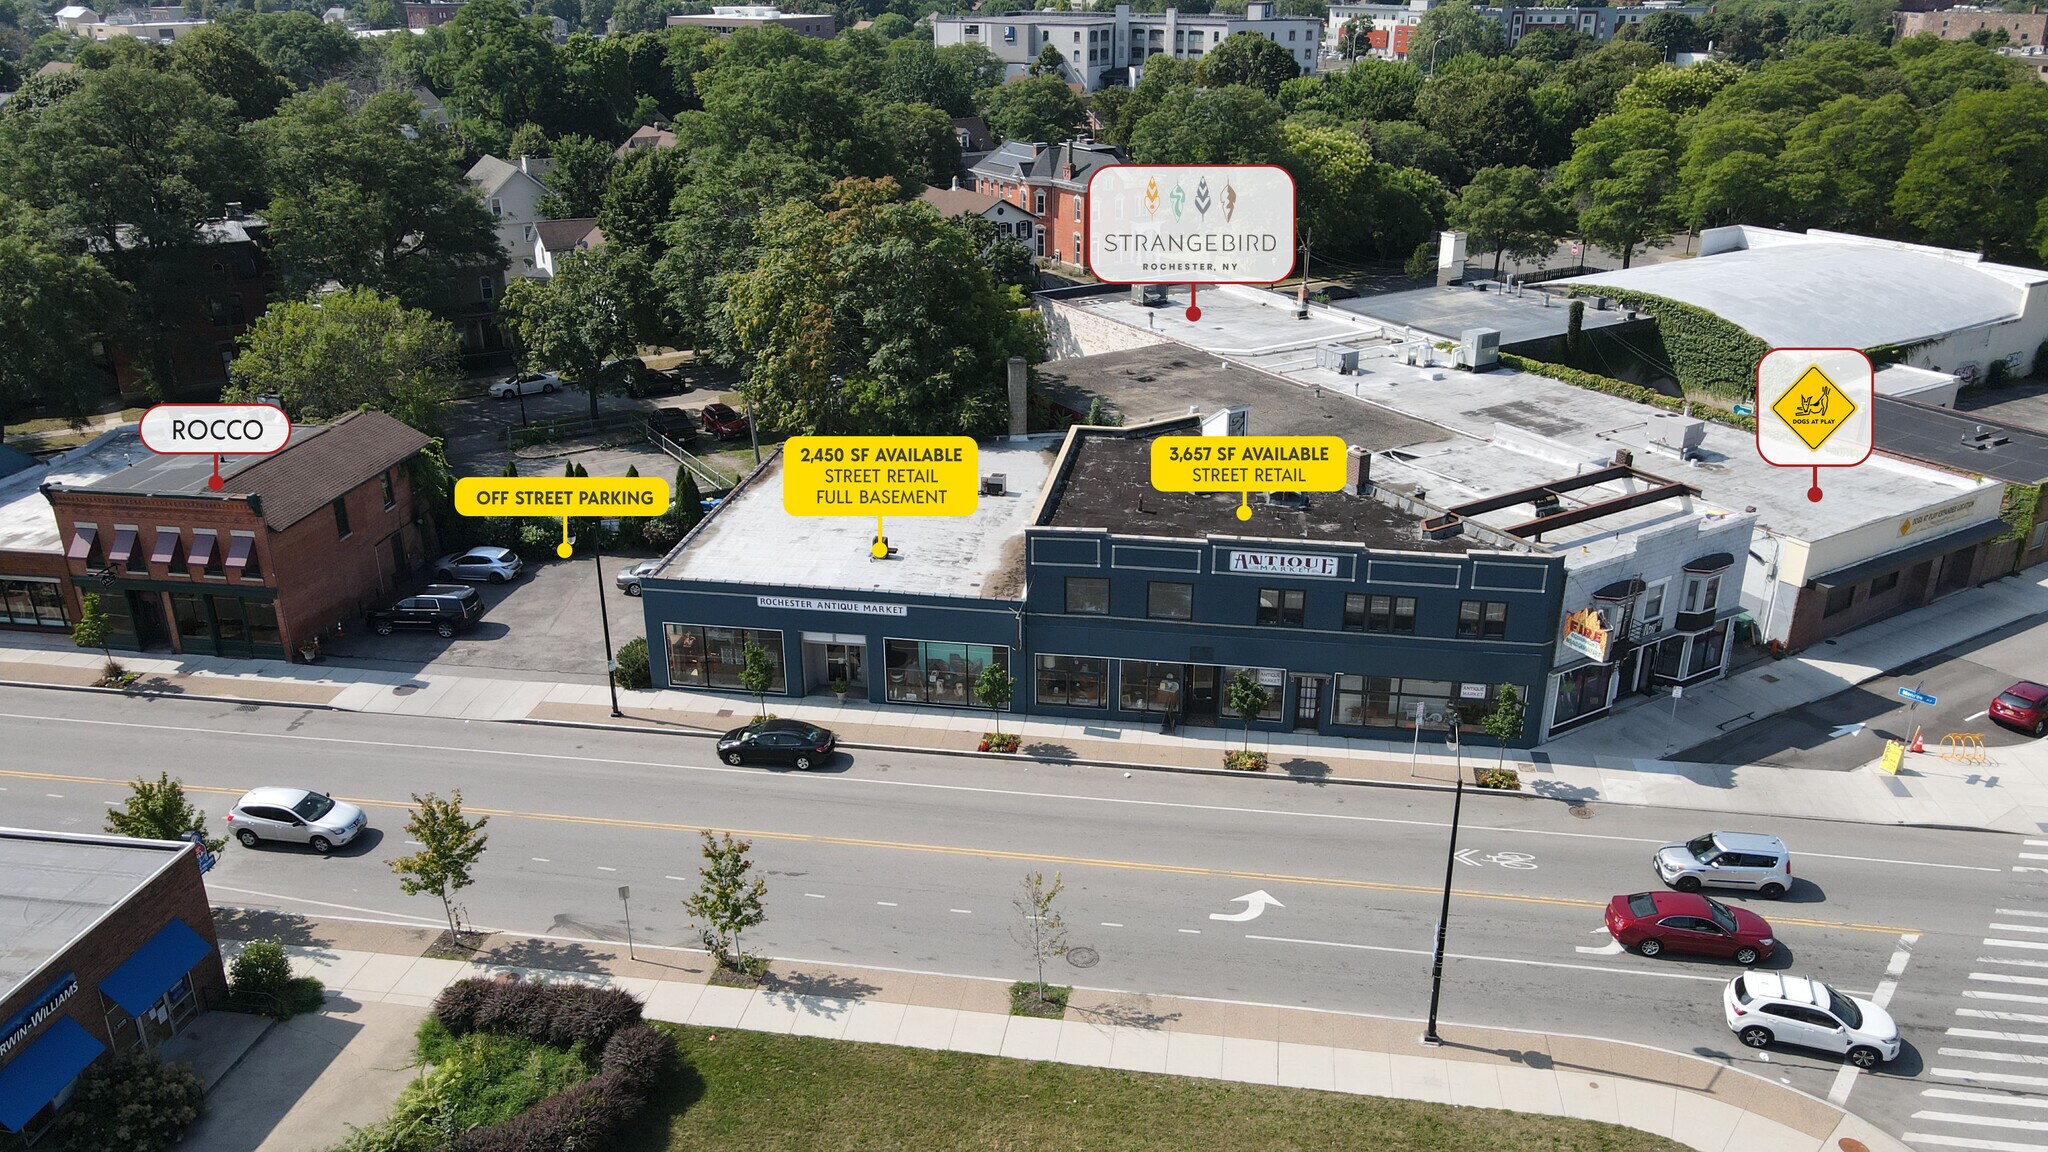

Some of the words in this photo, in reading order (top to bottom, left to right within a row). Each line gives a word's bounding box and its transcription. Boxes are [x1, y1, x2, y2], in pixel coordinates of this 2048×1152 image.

[1234, 553, 1335, 575] ANTIQUE
[1259, 565, 1311, 574] MARKET
[759, 597, 813, 608] ROCHESTER
[816, 600, 860, 612] ANTIQUE
[863, 604, 904, 615] MARKET
[1569, 620, 1604, 644] FIRE
